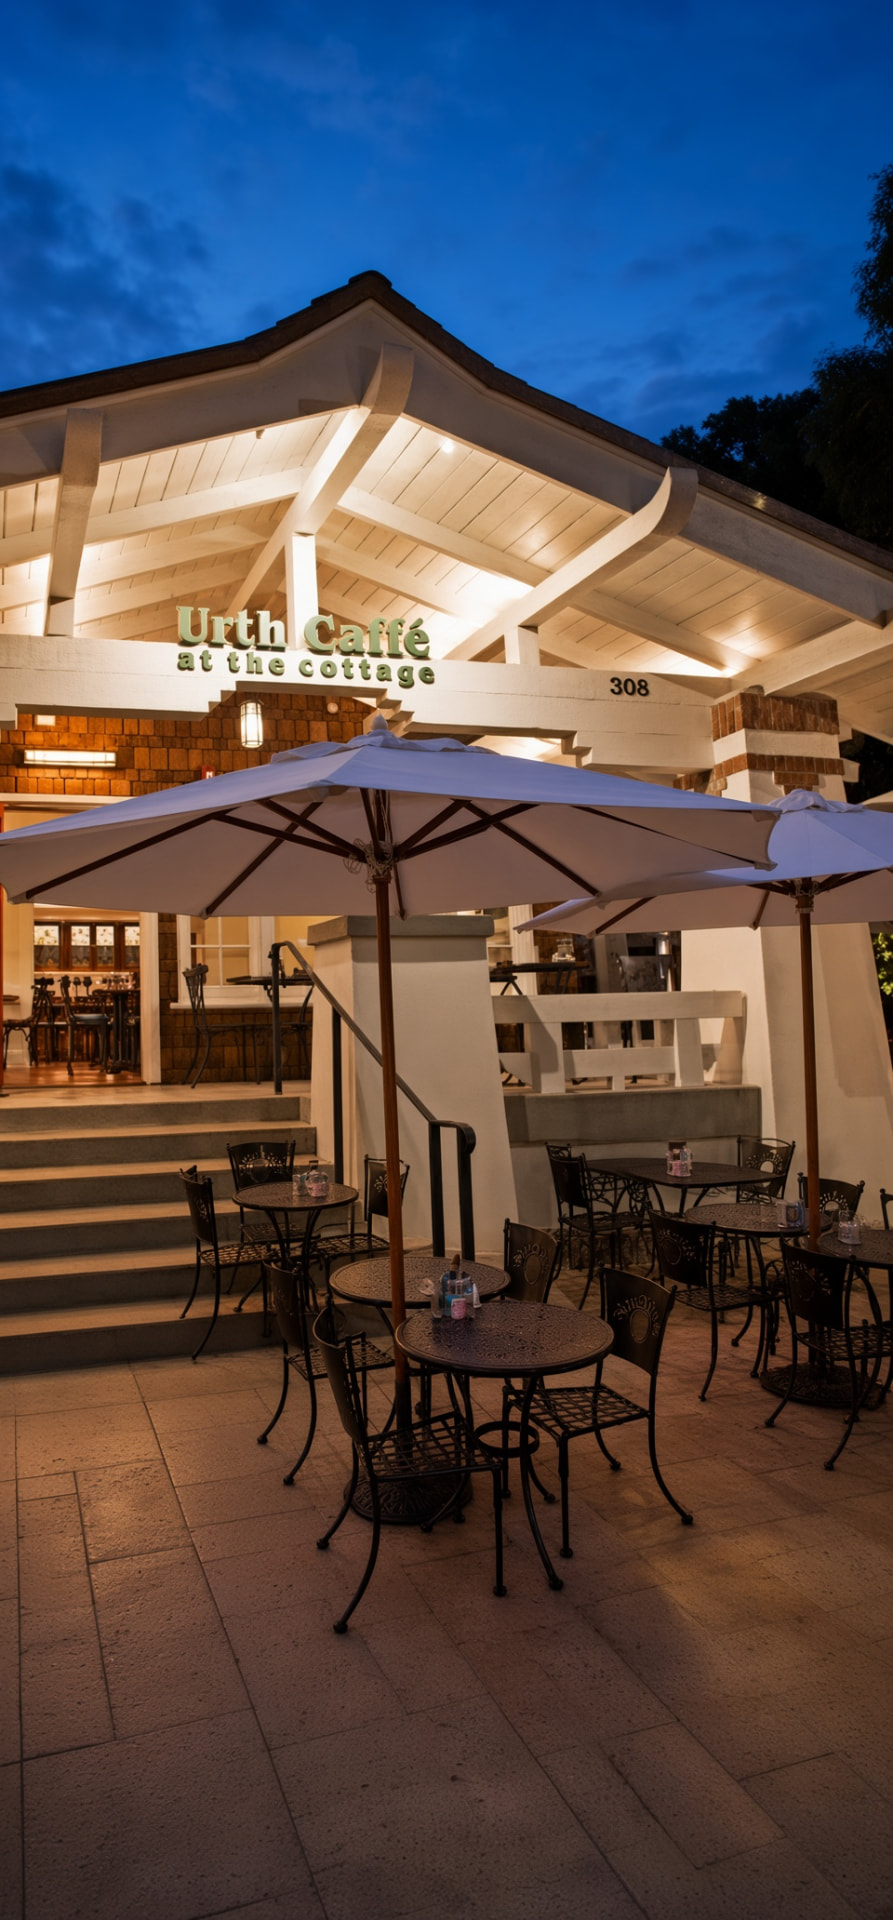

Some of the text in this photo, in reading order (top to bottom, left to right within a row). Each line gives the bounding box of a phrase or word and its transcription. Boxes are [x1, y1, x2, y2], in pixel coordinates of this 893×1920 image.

[176, 605, 431, 658] Urth Caffé
[177, 650, 435, 687] at the cottage
[610, 677, 650, 697] 308
